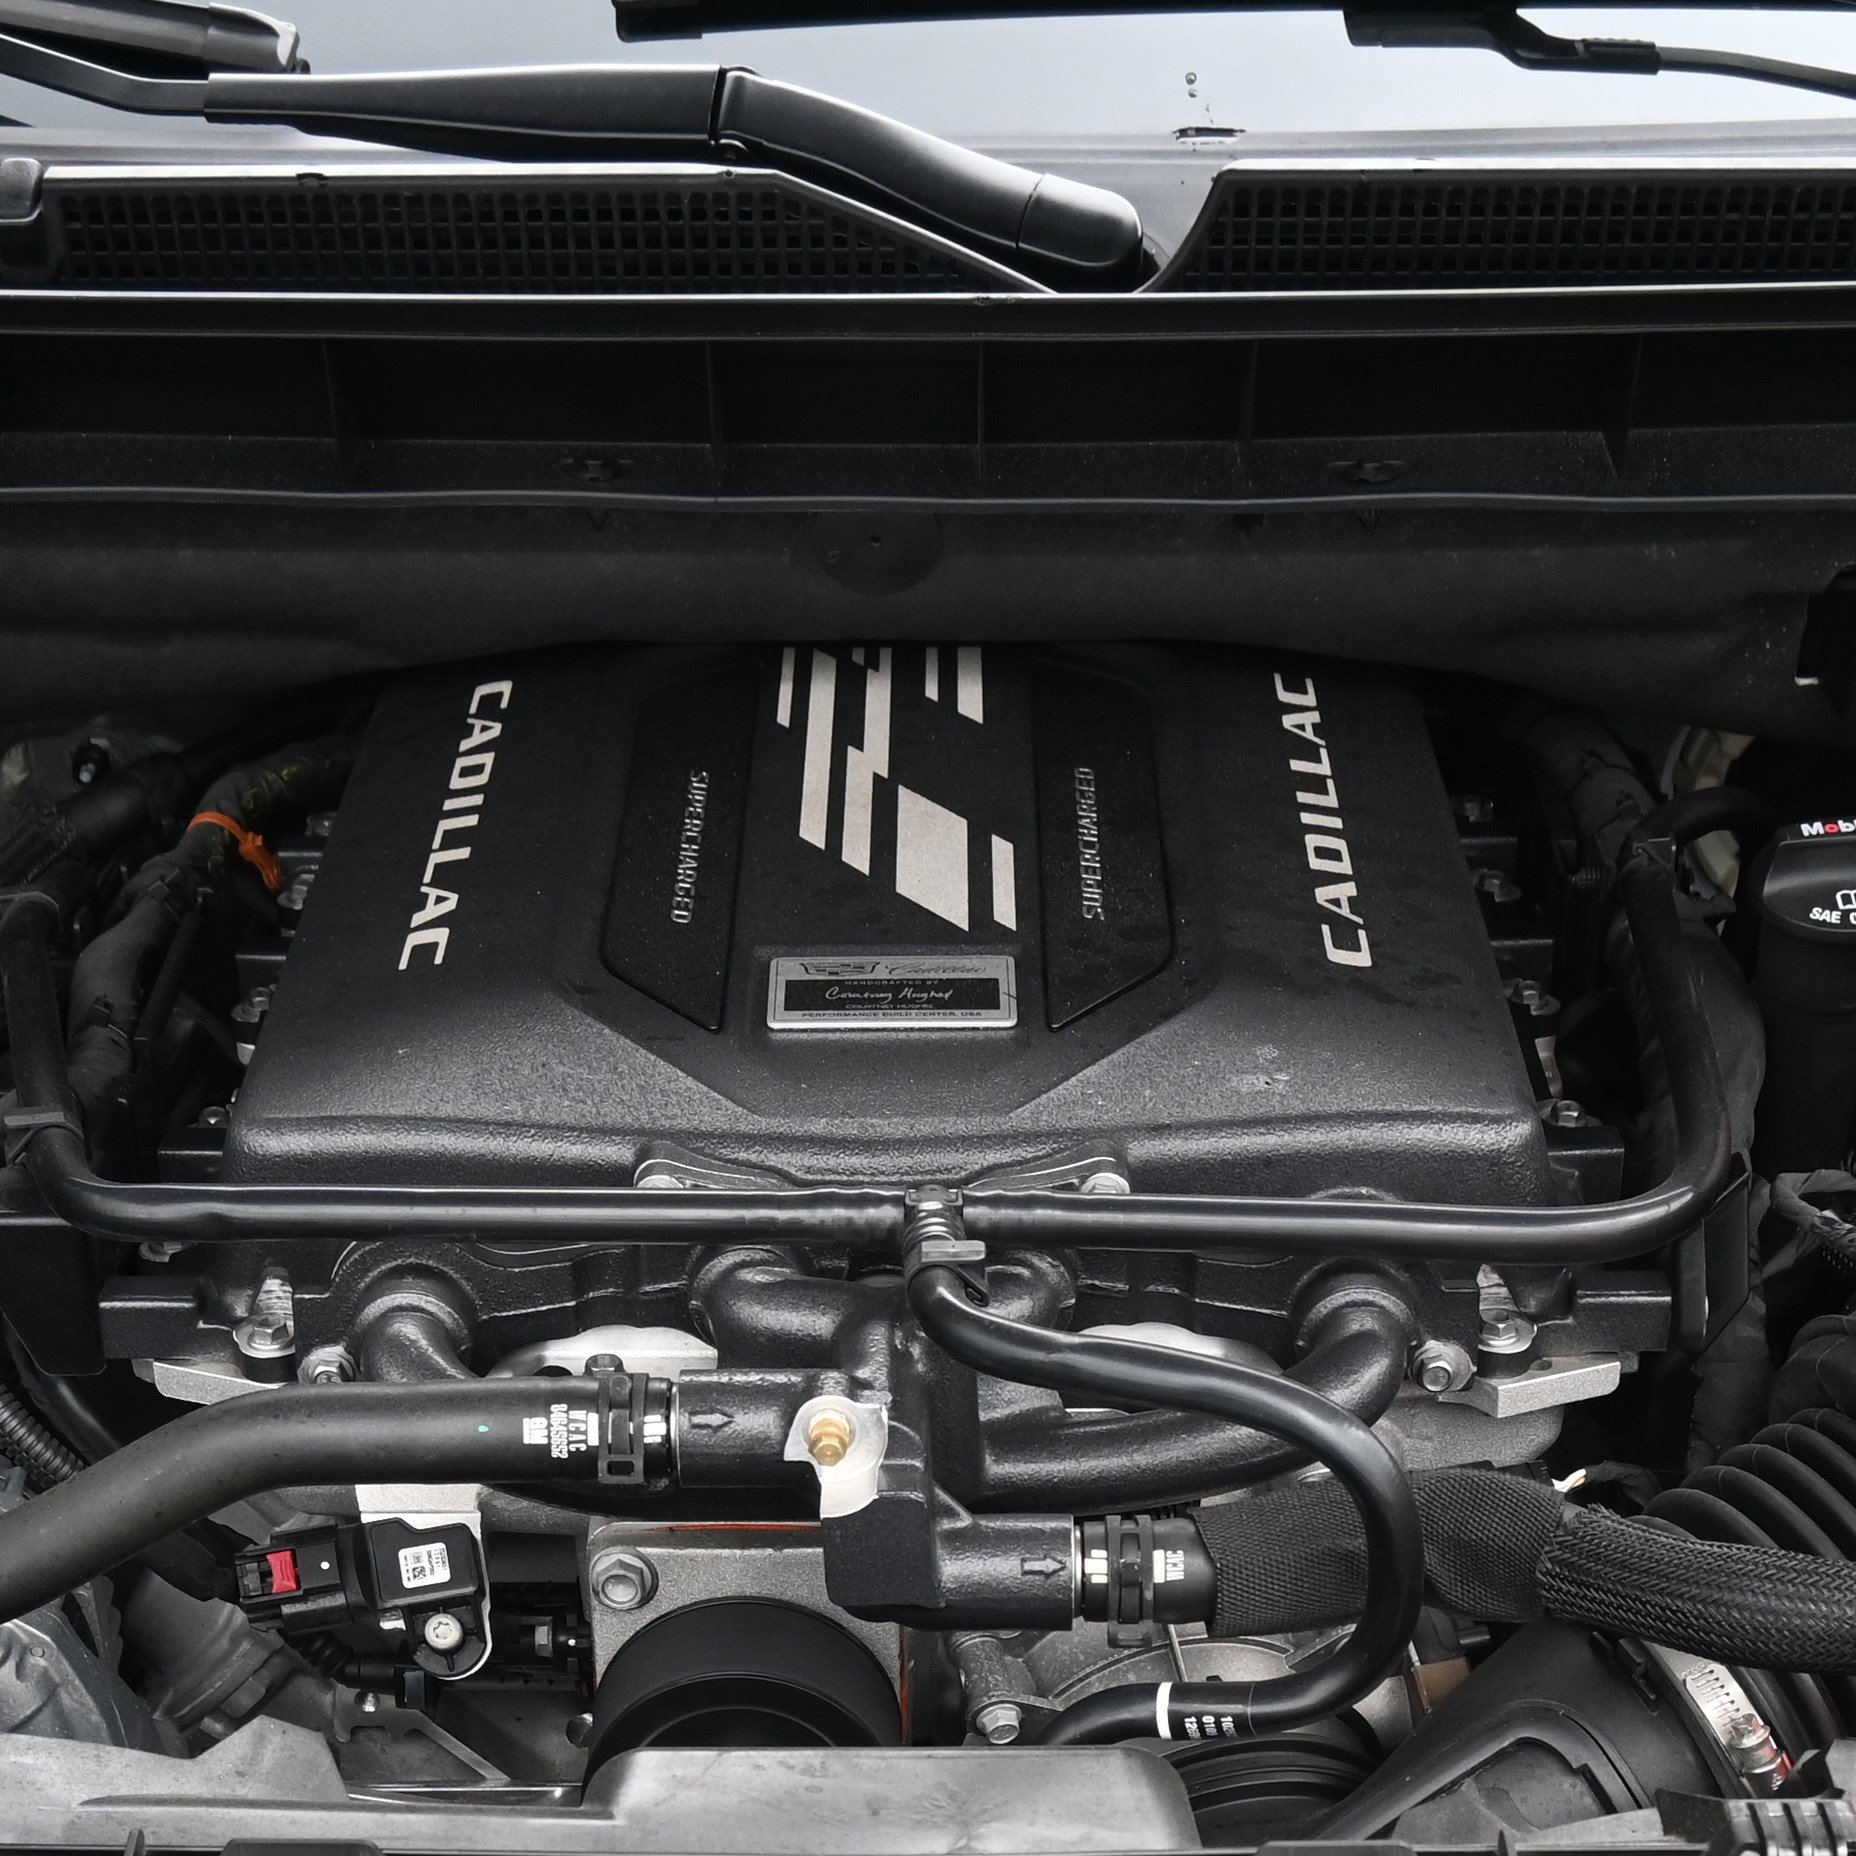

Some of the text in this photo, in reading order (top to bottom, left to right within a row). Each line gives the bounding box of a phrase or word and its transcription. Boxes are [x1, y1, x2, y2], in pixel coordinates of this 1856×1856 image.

[399, 682, 511, 969] CADILLAC
[670, 769, 709, 925] SUPERCHARGED
[1080, 765, 1103, 923] SUPERCHARGED
[1274, 673, 1372, 967] CADILLAC
[1809, 907, 1842, 924] SAE
[523, 1417, 548, 1445] GM
